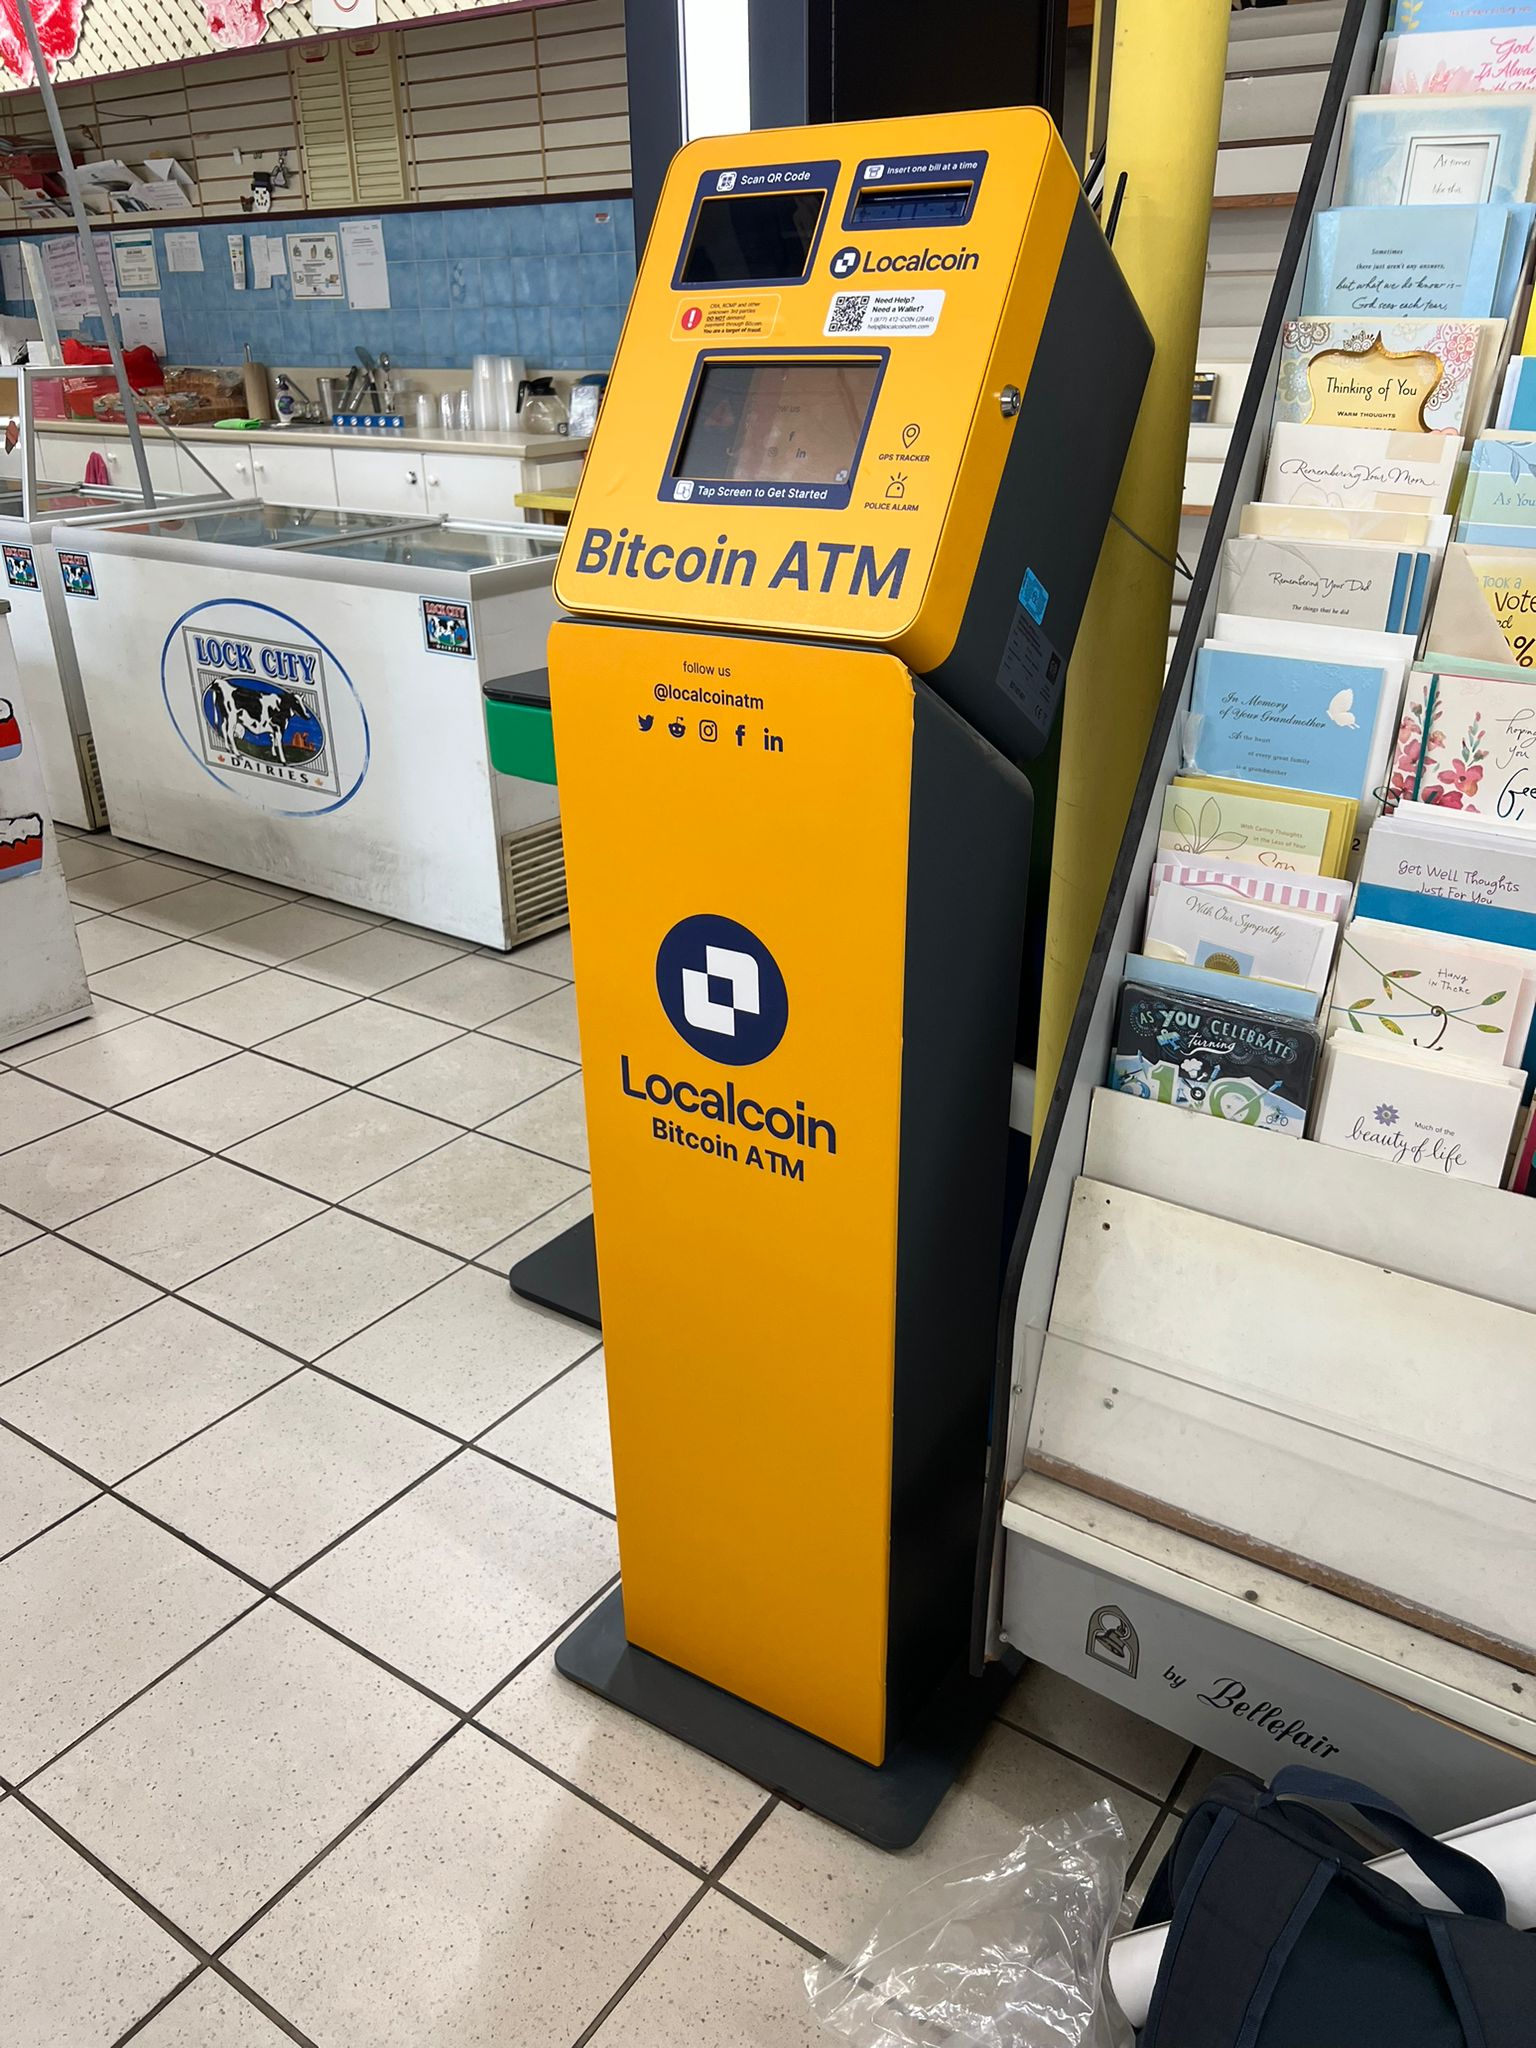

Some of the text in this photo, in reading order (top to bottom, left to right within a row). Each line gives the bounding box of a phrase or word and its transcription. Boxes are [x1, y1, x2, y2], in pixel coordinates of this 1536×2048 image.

[1490, 36, 1535, 64] God
[1474, 62, 1493, 82] Is
[741, 170, 810, 186] Scan QR Code
[887, 166, 910, 175] Insert
[912, 166, 926, 174] one
[929, 163, 940, 172] bill
[942, 163, 951, 171] at
[959, 161, 979, 170] time
[863, 247, 979, 273] Localcoin
[1373, 263, 1385, 271] just
[1419, 263, 1445, 271] answers,
[1336, 277, 1356, 292] but
[1356, 276, 1383, 293] what
[1383, 281, 1400, 290] we
[1401, 277, 1416, 289] do
[1415, 276, 1444, 289] know
[1352, 297, 1448, 311] God sees each tear,
[1327, 377, 1417, 401] Thinking of You
[878, 453, 930, 462] GPS TRACKER
[1279, 458, 1440, 490] Remembering Your Mom
[699, 485, 828, 499] Tap Screen to Get Started
[1493, 492, 1511, 506] As
[864, 502, 919, 511] POLICE ALARM
[575, 527, 911, 600] Bitcoin ATM
[1268, 572, 1372, 598] Remembering Your Dad
[425, 602, 465, 619] LOCK CITY
[193, 635, 316, 684] LOCK CITY
[683, 661, 731, 677] follow us
[654, 683, 764, 710] @localcoinatm
[1221, 692, 1288, 712] In Memory
[1219, 706, 1326, 728] of Your Grandmother
[1255, 752, 1271, 760] every
[1290, 756, 1310, 765] family
[1496, 745, 1529, 770] you
[231, 756, 309, 784] DAIRIES
[1248, 766, 1287, 776] grandmother
[1240, 823, 1303, 839] With Caring Thoughts
[1271, 839, 1284, 847] Loss
[1351, 838, 1361, 851] 2
[1416, 882, 1493, 904] Just For You
[1464, 871, 1520, 895] Thoughts
[1185, 896, 1287, 943] With Our Sympathy
[1140, 1010, 1291, 1059] AS YOU CELEBRATE
[1187, 1033, 1236, 1052] turning
[621, 1054, 837, 1155] Localcoin
[1152, 1064, 1262, 1128] 10
[1414, 1121, 1455, 1137] Much of the
[652, 1117, 805, 1182] Bitcoin ATM
[1345, 1116, 1468, 1174] beauty of life
[1162, 1665, 1340, 1759] by Bellefair
